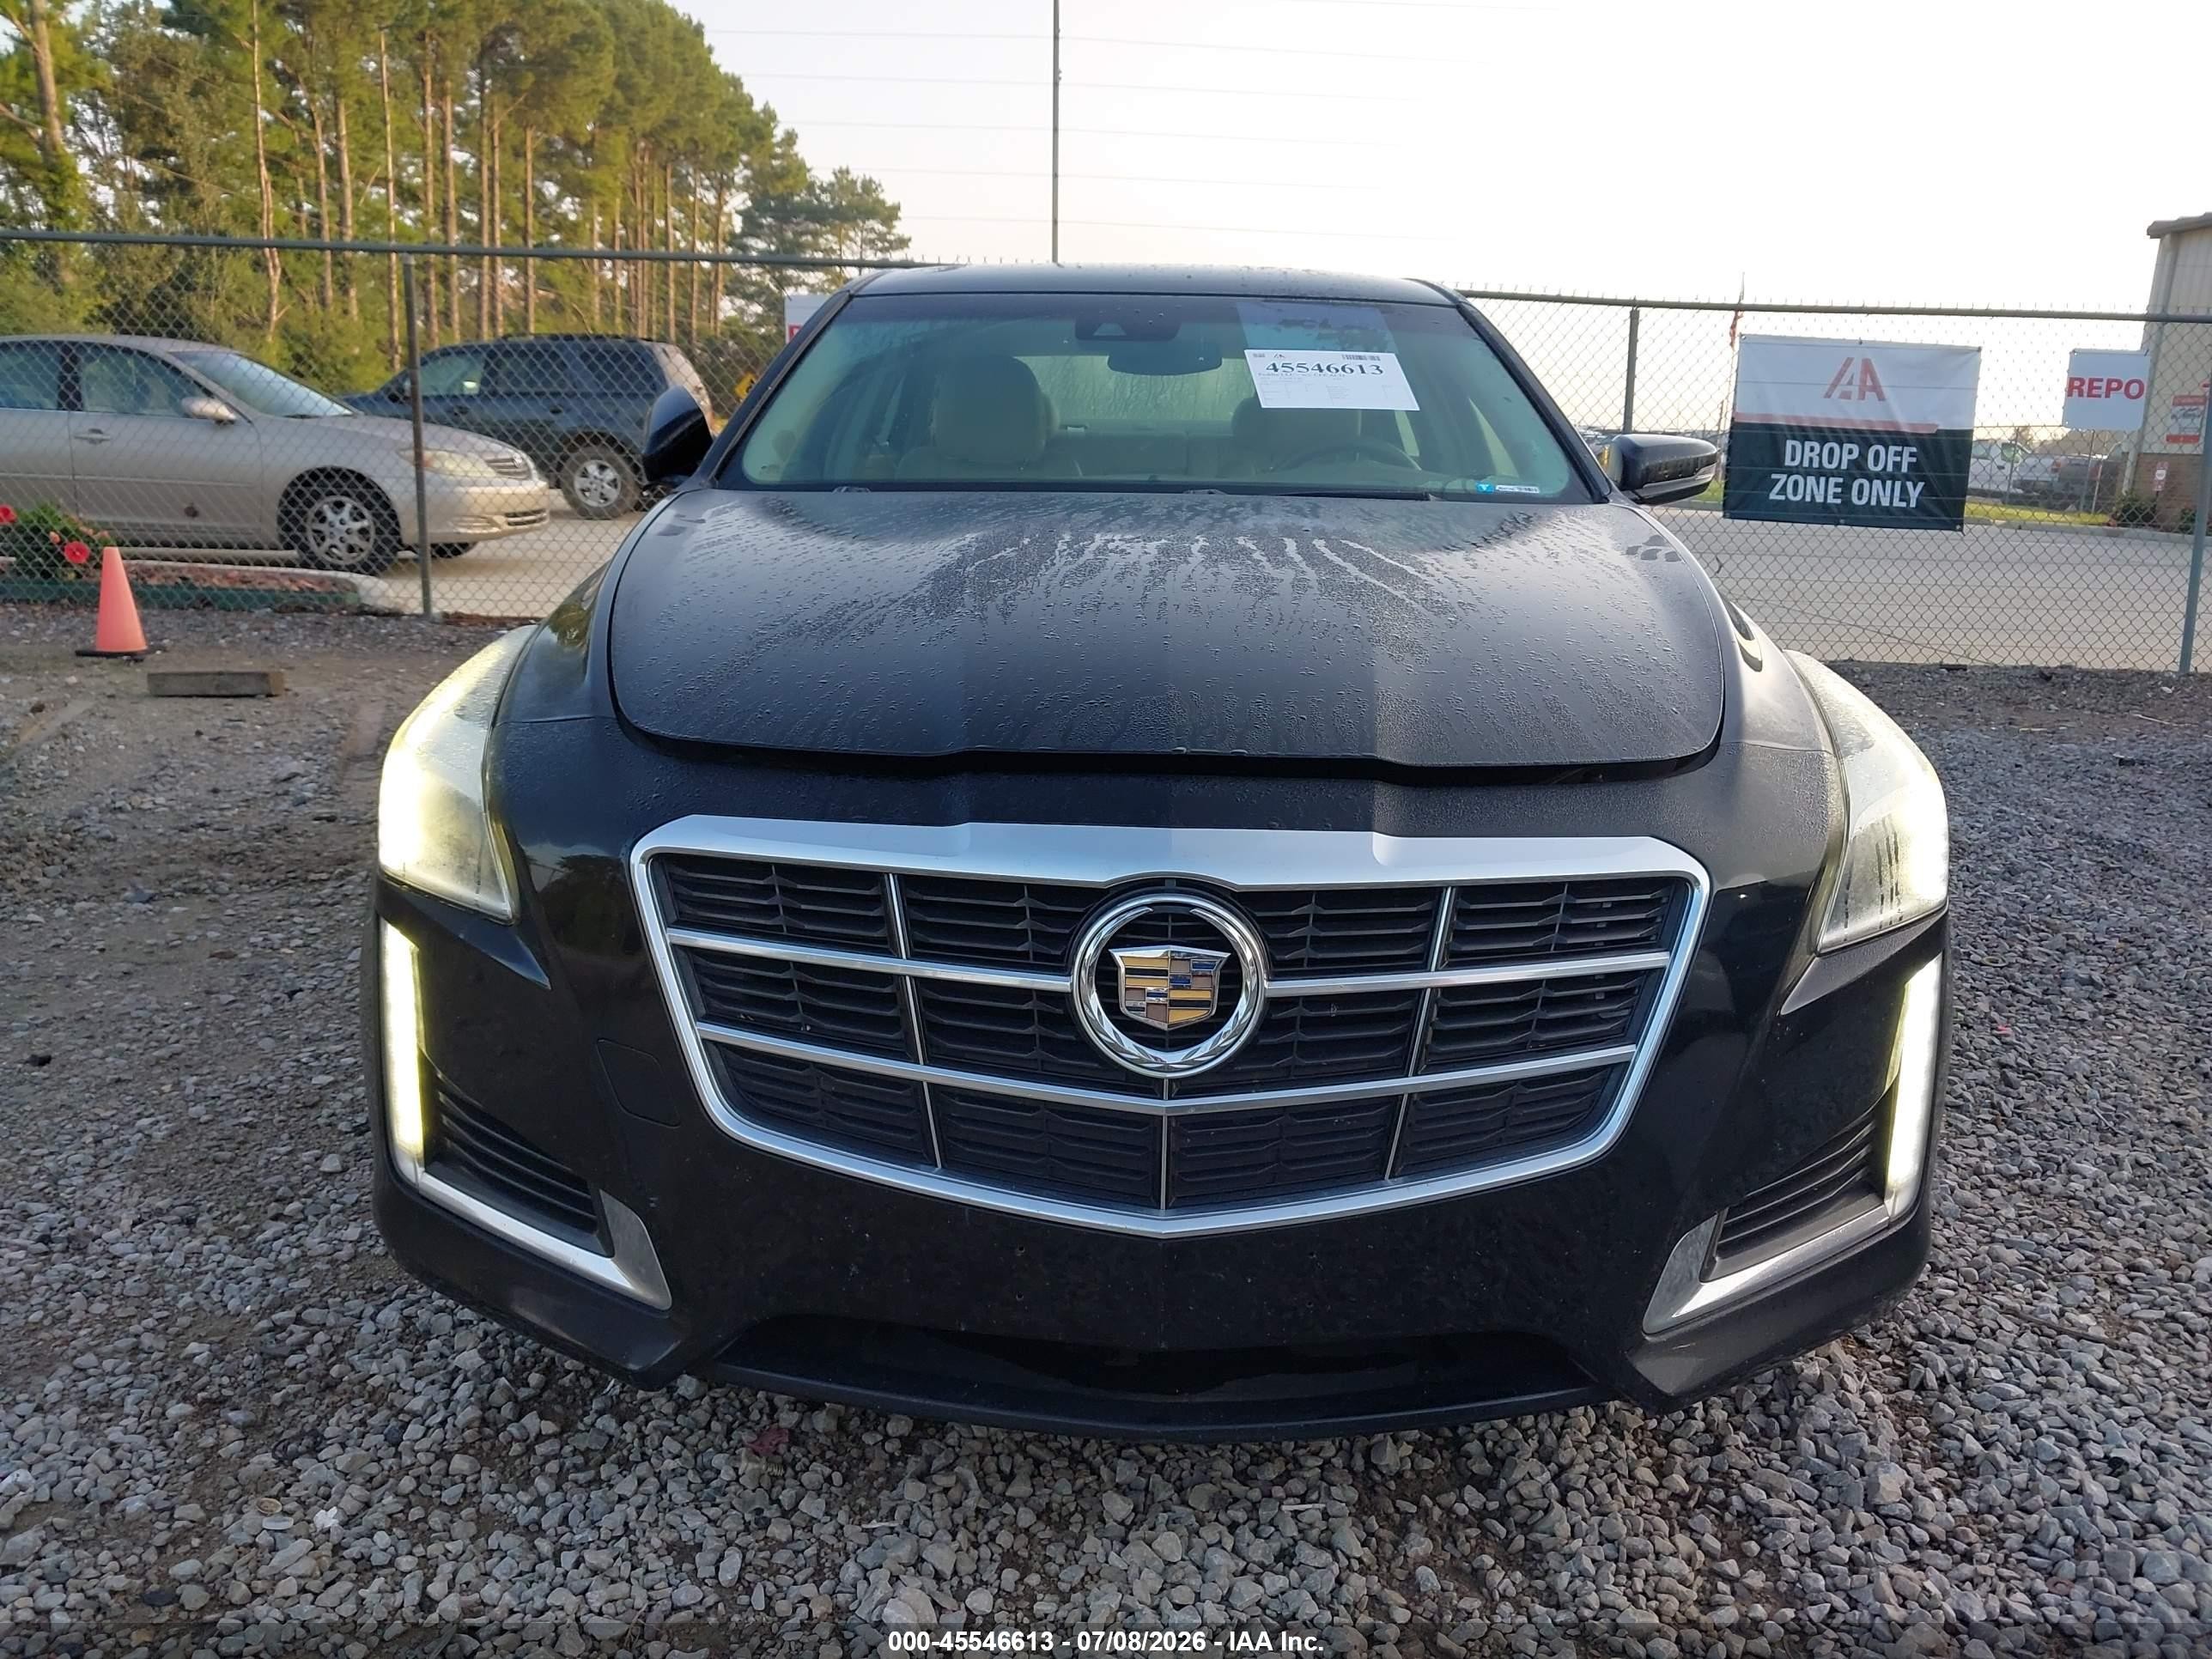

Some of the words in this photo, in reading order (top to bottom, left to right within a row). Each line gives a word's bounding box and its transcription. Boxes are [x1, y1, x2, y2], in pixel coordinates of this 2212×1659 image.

[1266, 362, 1383, 375] 45546613
[2066, 376, 2145, 400] REPO
[1784, 439, 1860, 470] DROP
[1867, 444, 1917, 472] OFF
[1768, 473, 1844, 504] ZONE
[1850, 477, 1925, 508] ONLY
